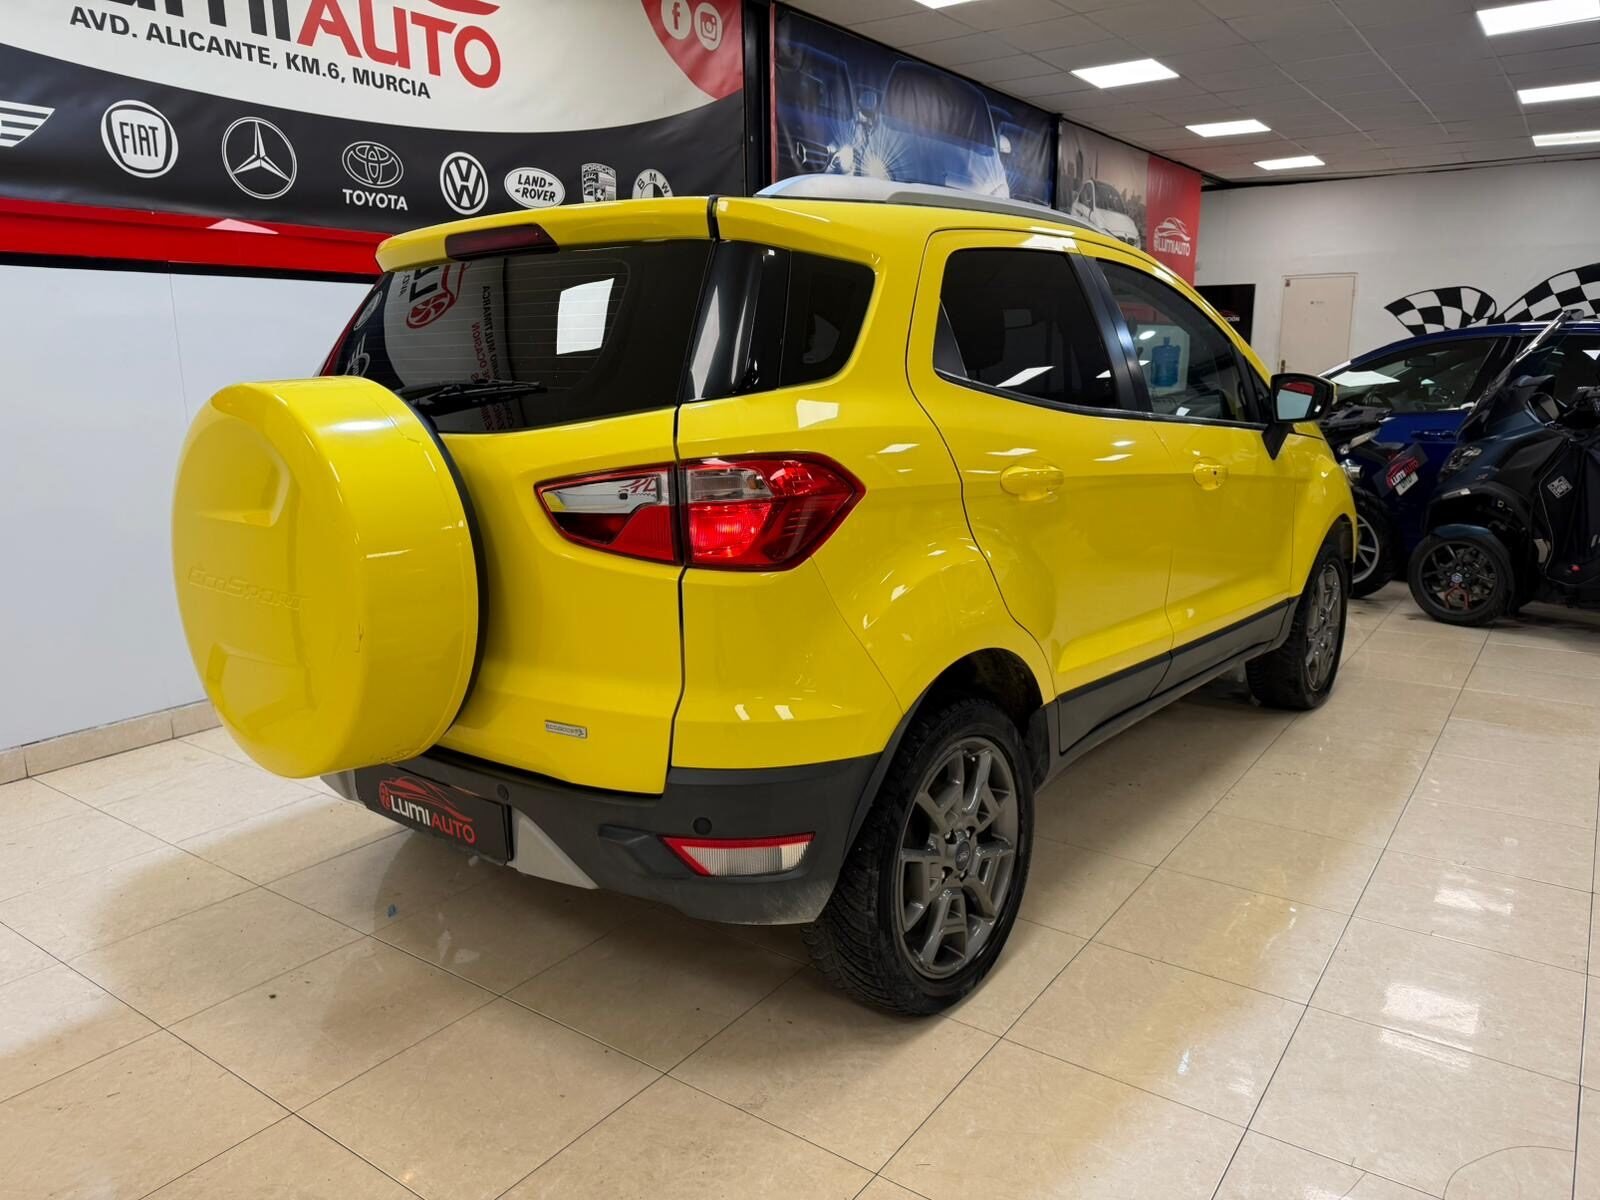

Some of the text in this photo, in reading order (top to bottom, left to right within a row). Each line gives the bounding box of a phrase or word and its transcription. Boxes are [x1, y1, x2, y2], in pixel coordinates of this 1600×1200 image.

[70, 6, 431, 99] AVD. ALICANTE, KM.6, MURCIA
[119, 121, 158, 157] FIAT
[517, 173, 547, 189] LAND
[636, 171, 670, 194] BMW
[342, 188, 408, 211] TOYOTA
[521, 186, 556, 203] ROVER
[390, 794, 478, 846] LUMIAUTO
